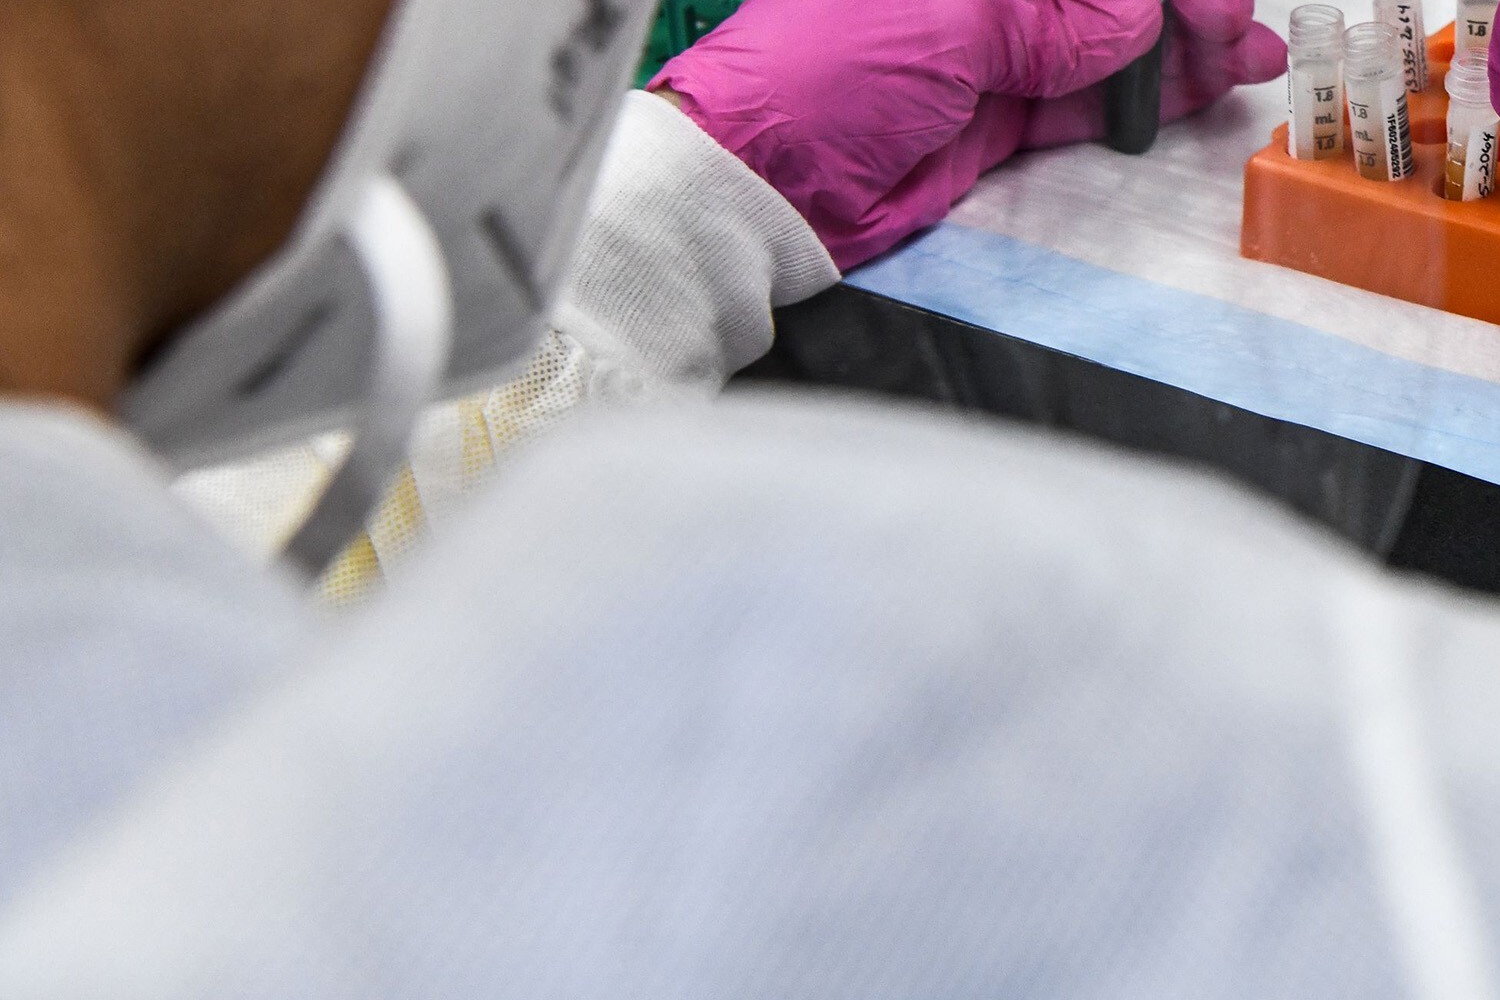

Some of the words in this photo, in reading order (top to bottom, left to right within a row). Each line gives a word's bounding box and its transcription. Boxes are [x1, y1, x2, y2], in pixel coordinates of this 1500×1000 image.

[1467, 24, 1486, 37] 1.8
[1315, 90, 1334, 102] 1.8
[1352, 106, 1368, 119] 1.8
[1315, 113, 1336, 125] mL
[1355, 130, 1374, 142] mL
[1316, 138, 1336, 151] 1.0
